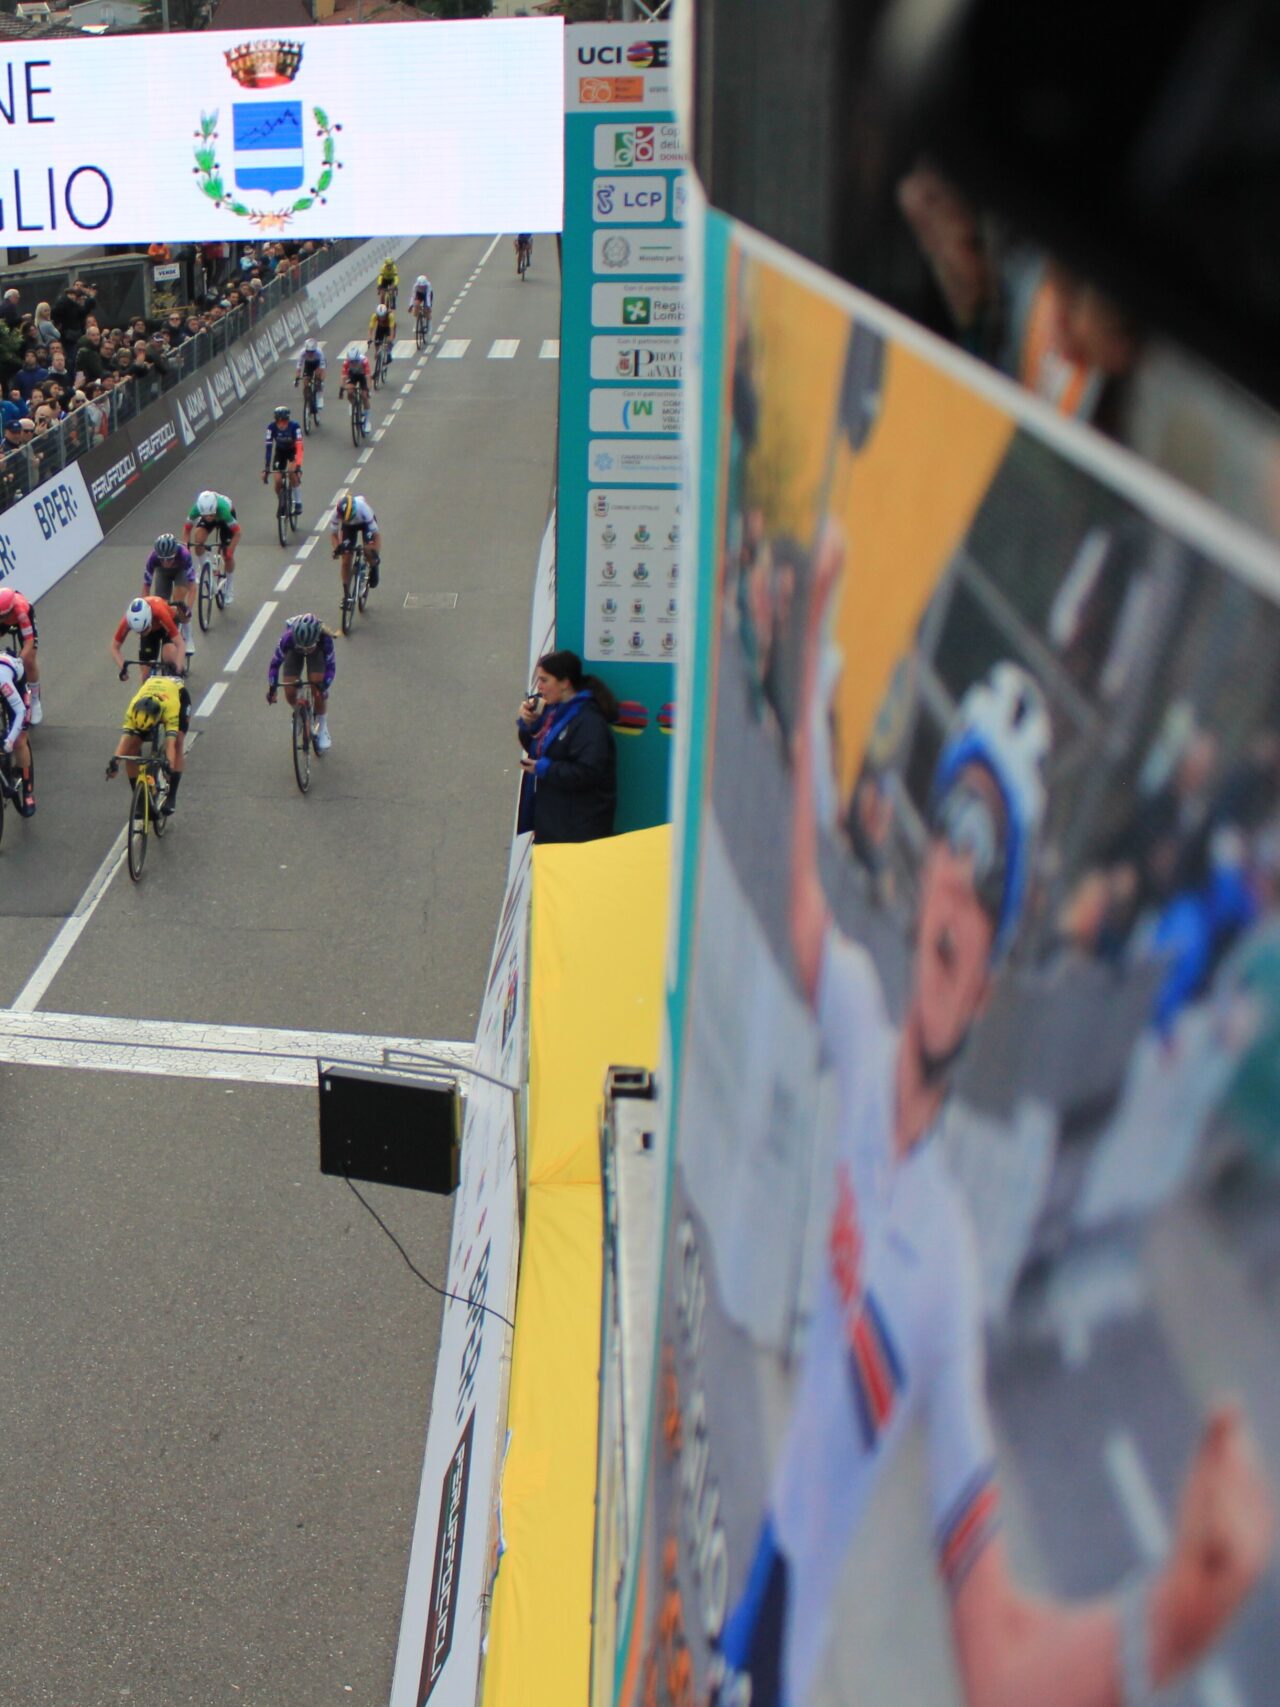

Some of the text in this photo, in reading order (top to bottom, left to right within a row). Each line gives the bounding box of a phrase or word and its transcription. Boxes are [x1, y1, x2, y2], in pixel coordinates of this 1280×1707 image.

[578, 46, 622, 65] UCI
[624, 192, 662, 207] LCP
[33, 484, 78, 541] BPER:
[430, 1440, 466, 1682] PERUFFOCICLI
